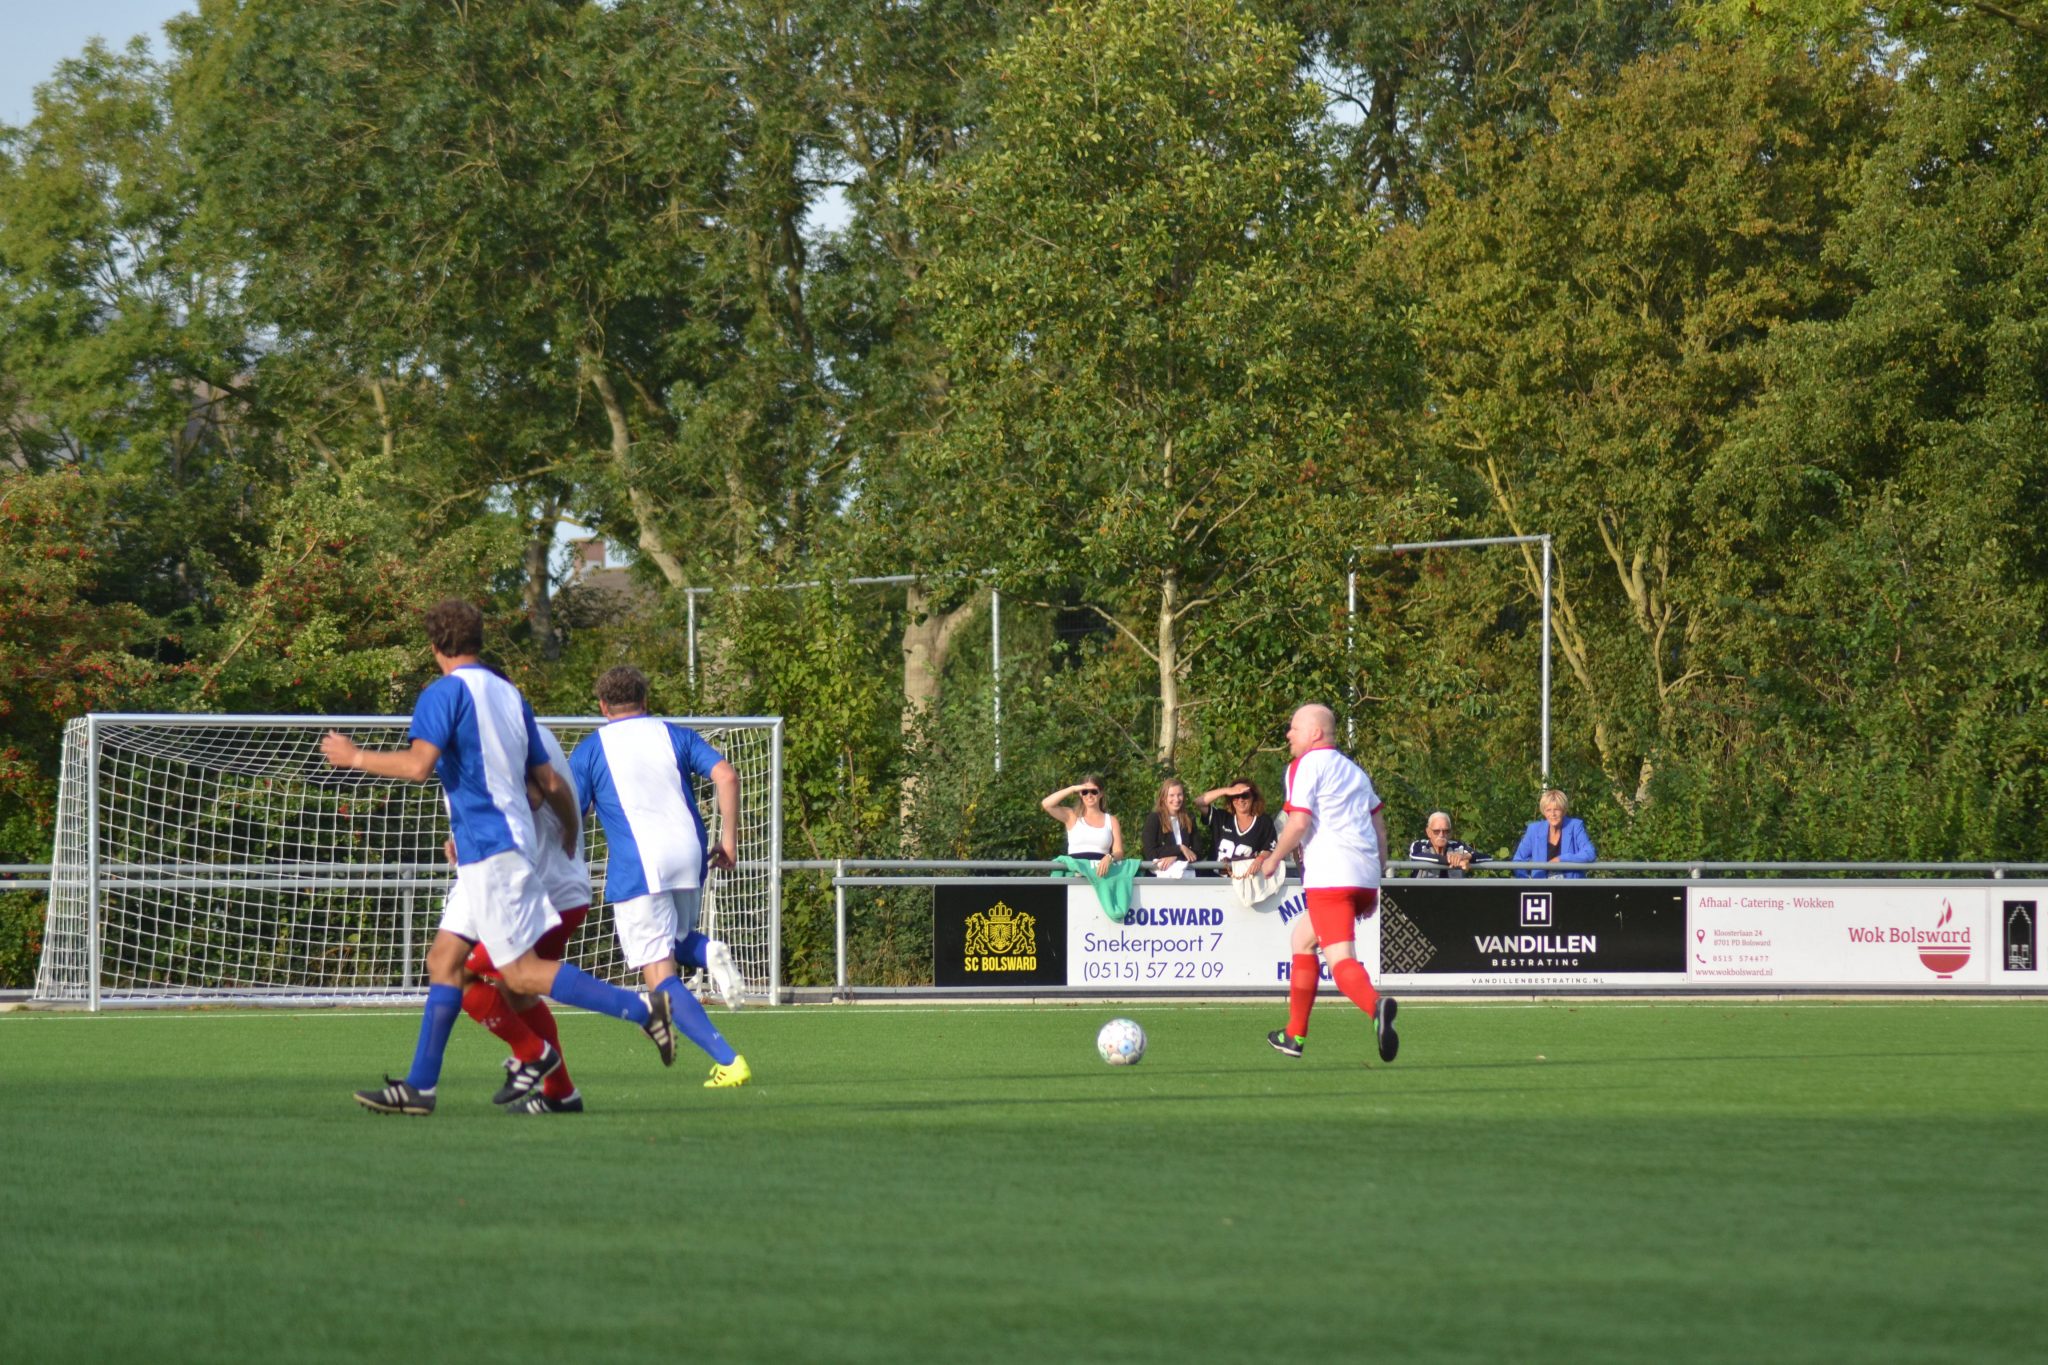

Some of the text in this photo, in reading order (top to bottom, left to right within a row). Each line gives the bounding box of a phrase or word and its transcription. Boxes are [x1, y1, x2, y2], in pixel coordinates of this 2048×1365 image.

[1699, 898, 1731, 908] Afhaal
[1740, 898, 1784, 910] Catering
[1793, 898, 1834, 908] Wokken
[1123, 908, 1224, 926] BOLSWARD
[1848, 927, 1971, 943] Wok Bolsward
[1084, 930, 1223, 958] Snekerpoort 7
[1475, 935, 1597, 953] VANDILLEN
[964, 956, 1037, 971] SC BOLSWARD
[1084, 962, 1224, 982] (0515) 57 22 09
[1695, 968, 1773, 976] www.wokbolsward.nl
